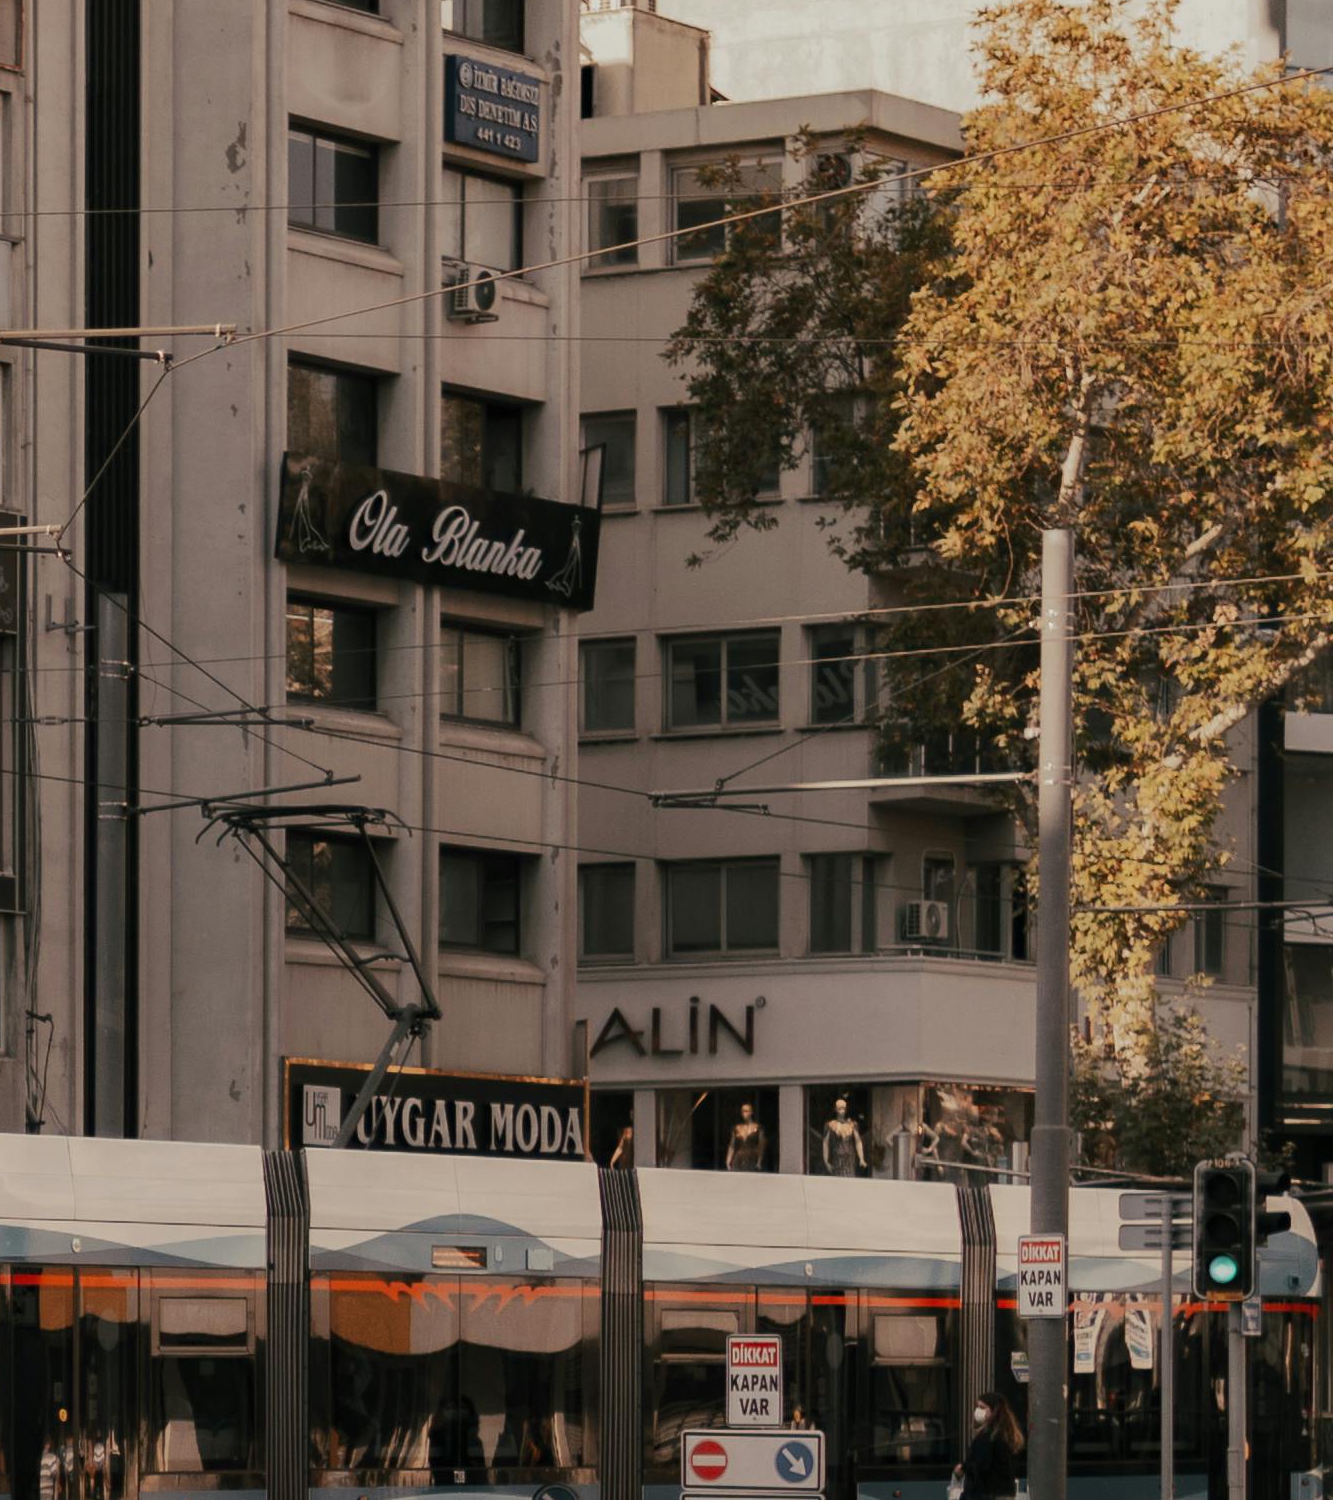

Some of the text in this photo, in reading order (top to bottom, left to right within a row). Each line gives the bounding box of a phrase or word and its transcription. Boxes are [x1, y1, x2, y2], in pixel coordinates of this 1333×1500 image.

[349, 489, 544, 580] Ola Blanka
[354, 1094, 585, 1155] UYGAR MODA
[1021, 1242, 1061, 1262] DİKKAT
[1020, 1270, 1062, 1286] KAPAN
[1028, 1292, 1054, 1307] VAR
[732, 1342, 778, 1366] DİKKAT
[730, 1374, 779, 1392] KAPAN
[739, 1398, 770, 1416] VAR
